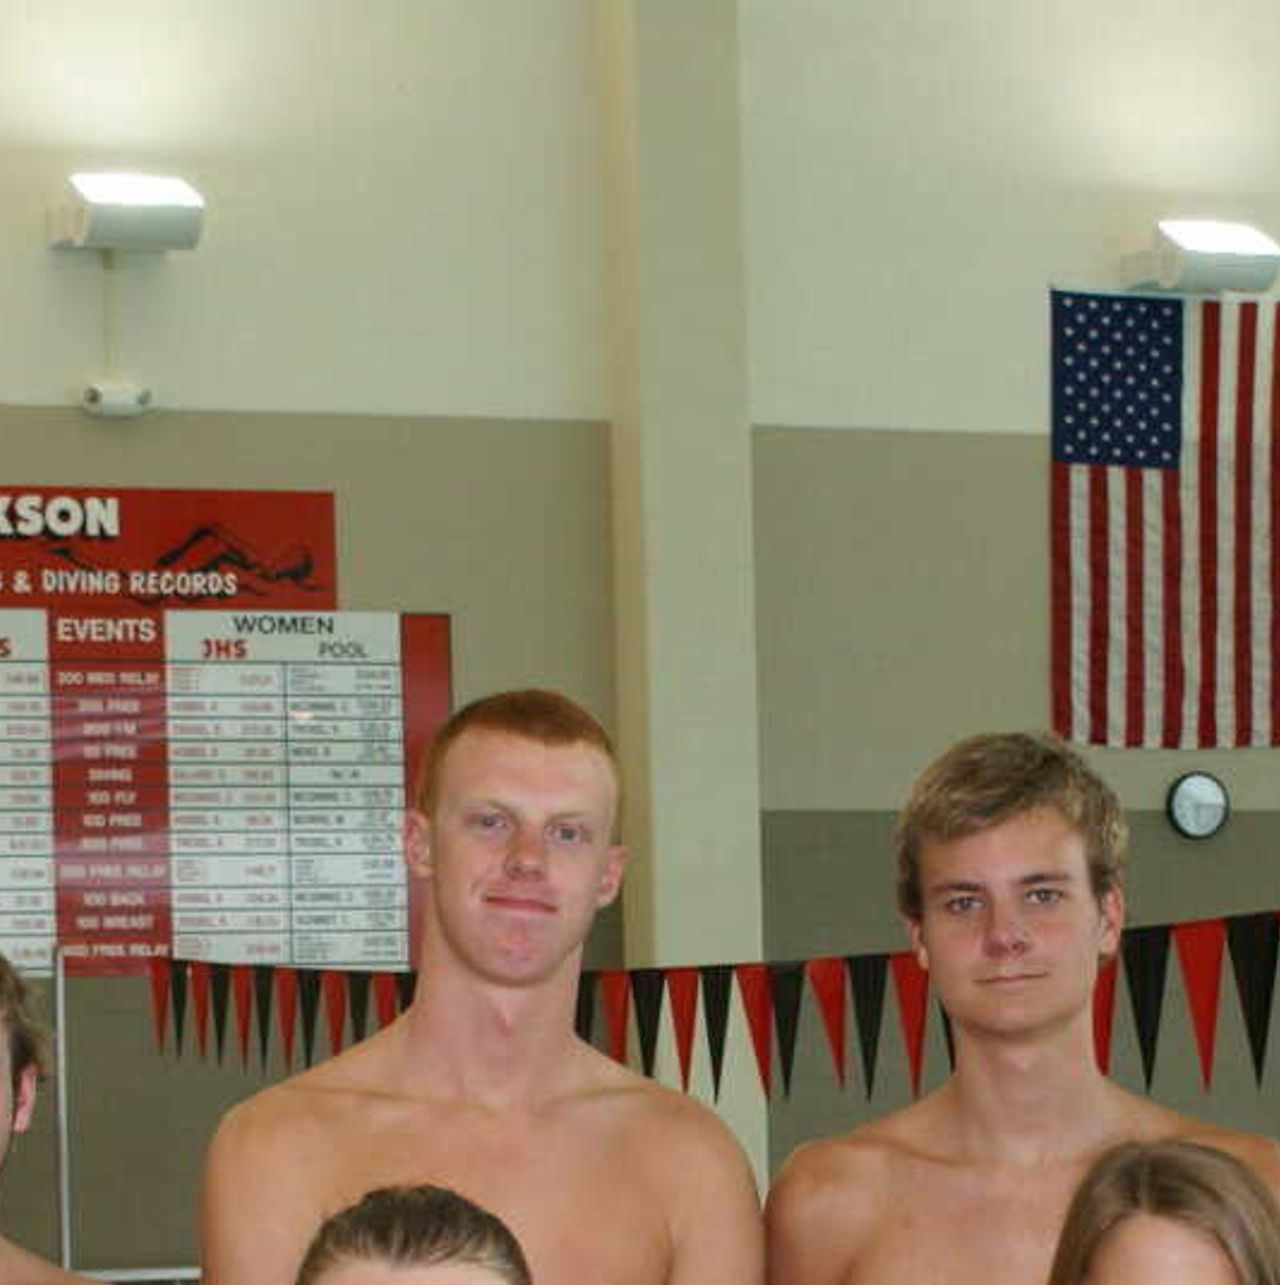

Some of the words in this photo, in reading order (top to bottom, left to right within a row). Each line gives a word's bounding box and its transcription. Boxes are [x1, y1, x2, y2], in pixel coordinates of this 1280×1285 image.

[13, 570, 31, 593] &
[42, 569, 121, 594] DIVING
[129, 571, 238, 597] RECORDS
[56, 616, 156, 643] EVENTS
[233, 615, 335, 635] WOMEN
[201, 638, 248, 660] JHS
[319, 641, 368, 659] POOL
